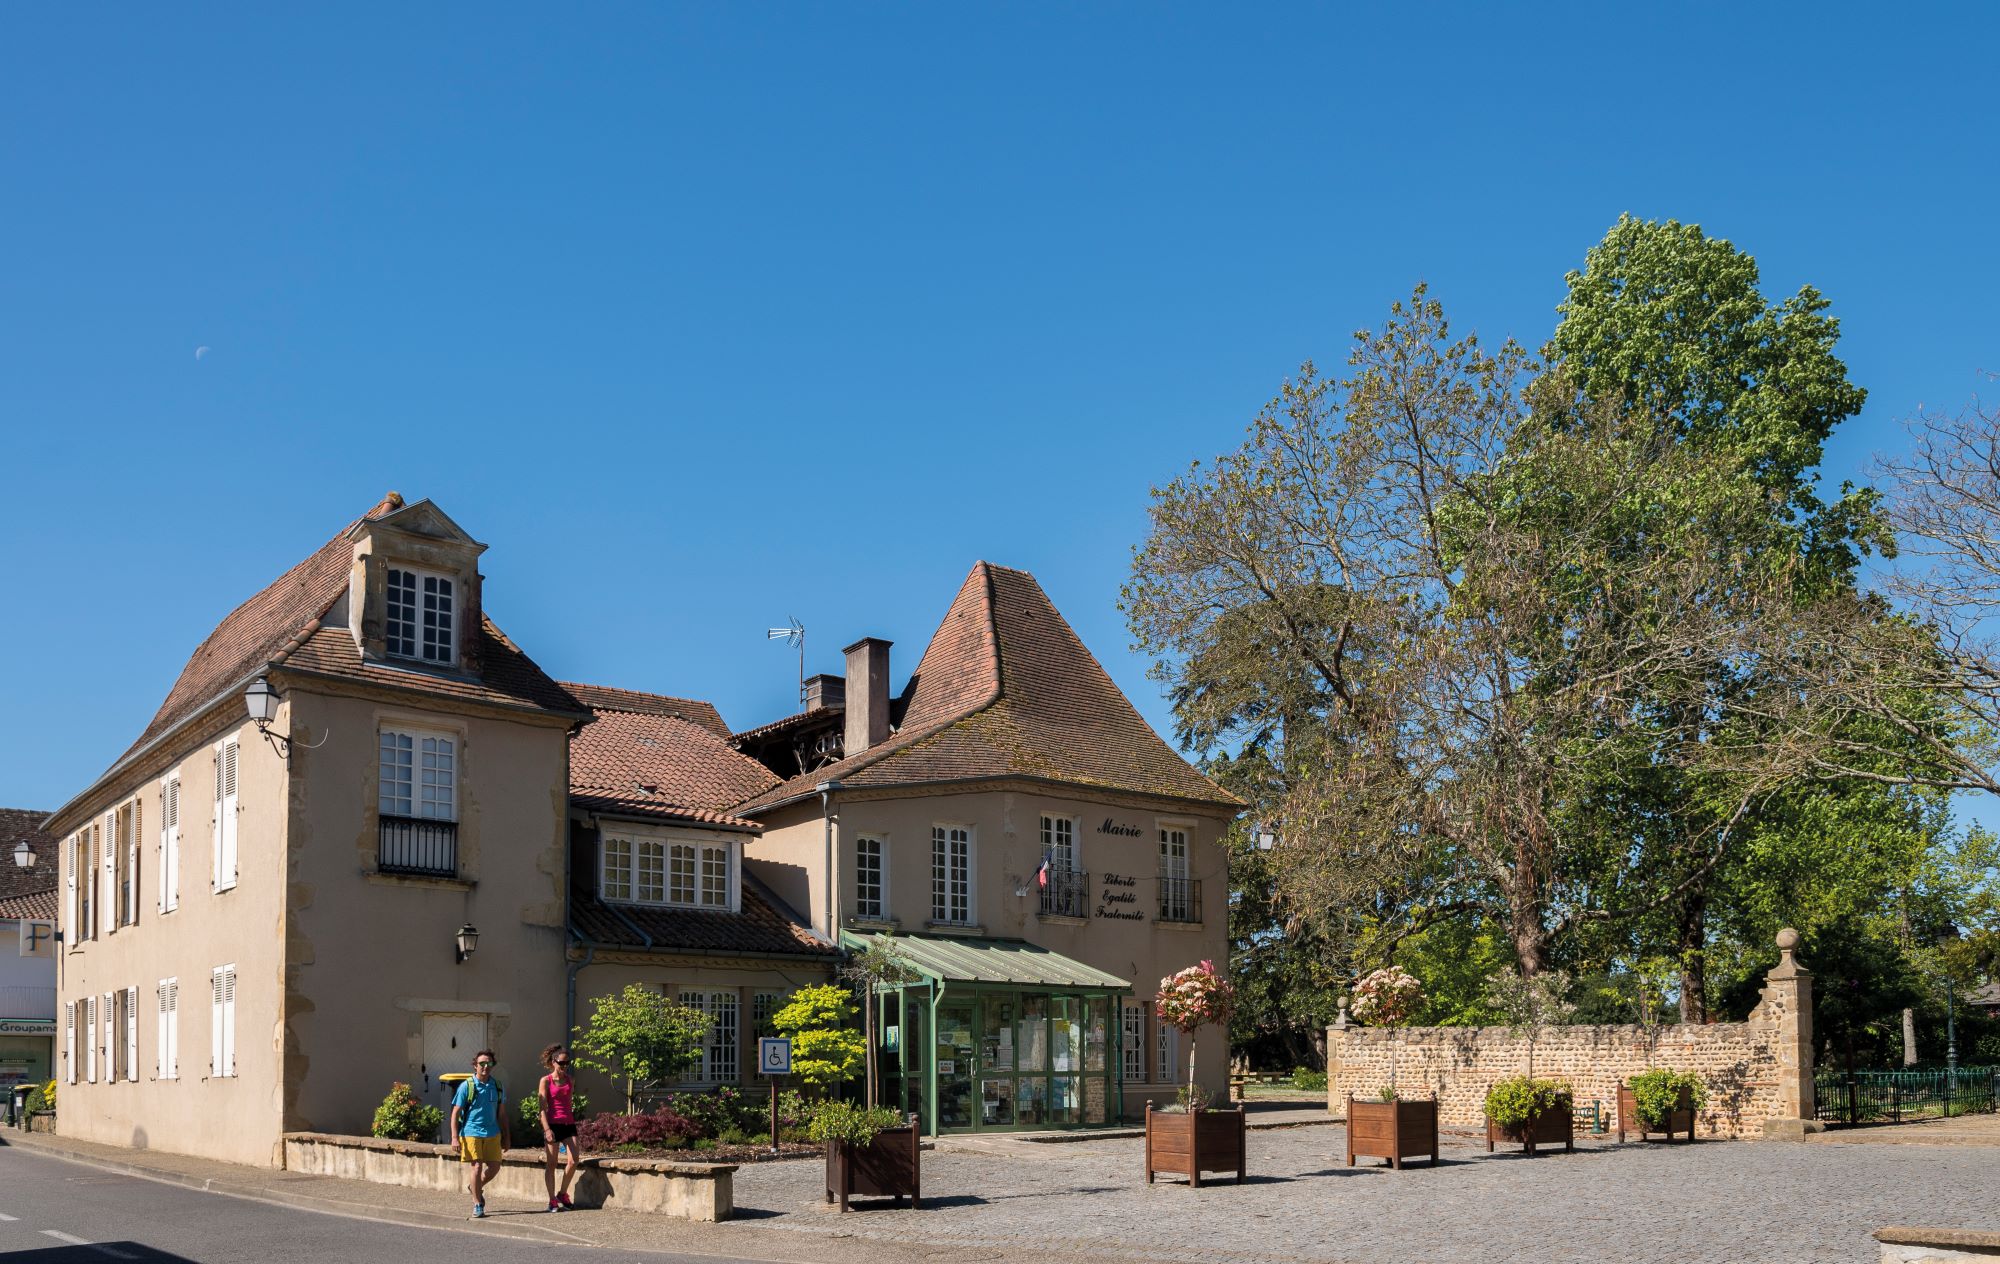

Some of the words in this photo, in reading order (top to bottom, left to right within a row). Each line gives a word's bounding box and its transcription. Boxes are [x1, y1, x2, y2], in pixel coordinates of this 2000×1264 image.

[1097, 818, 1143, 837] Mairie
[1103, 872, 1136, 887] Liberté
[1095, 905, 1144, 920] Fraternité
[0, 1023, 57, 1033] Groupama
